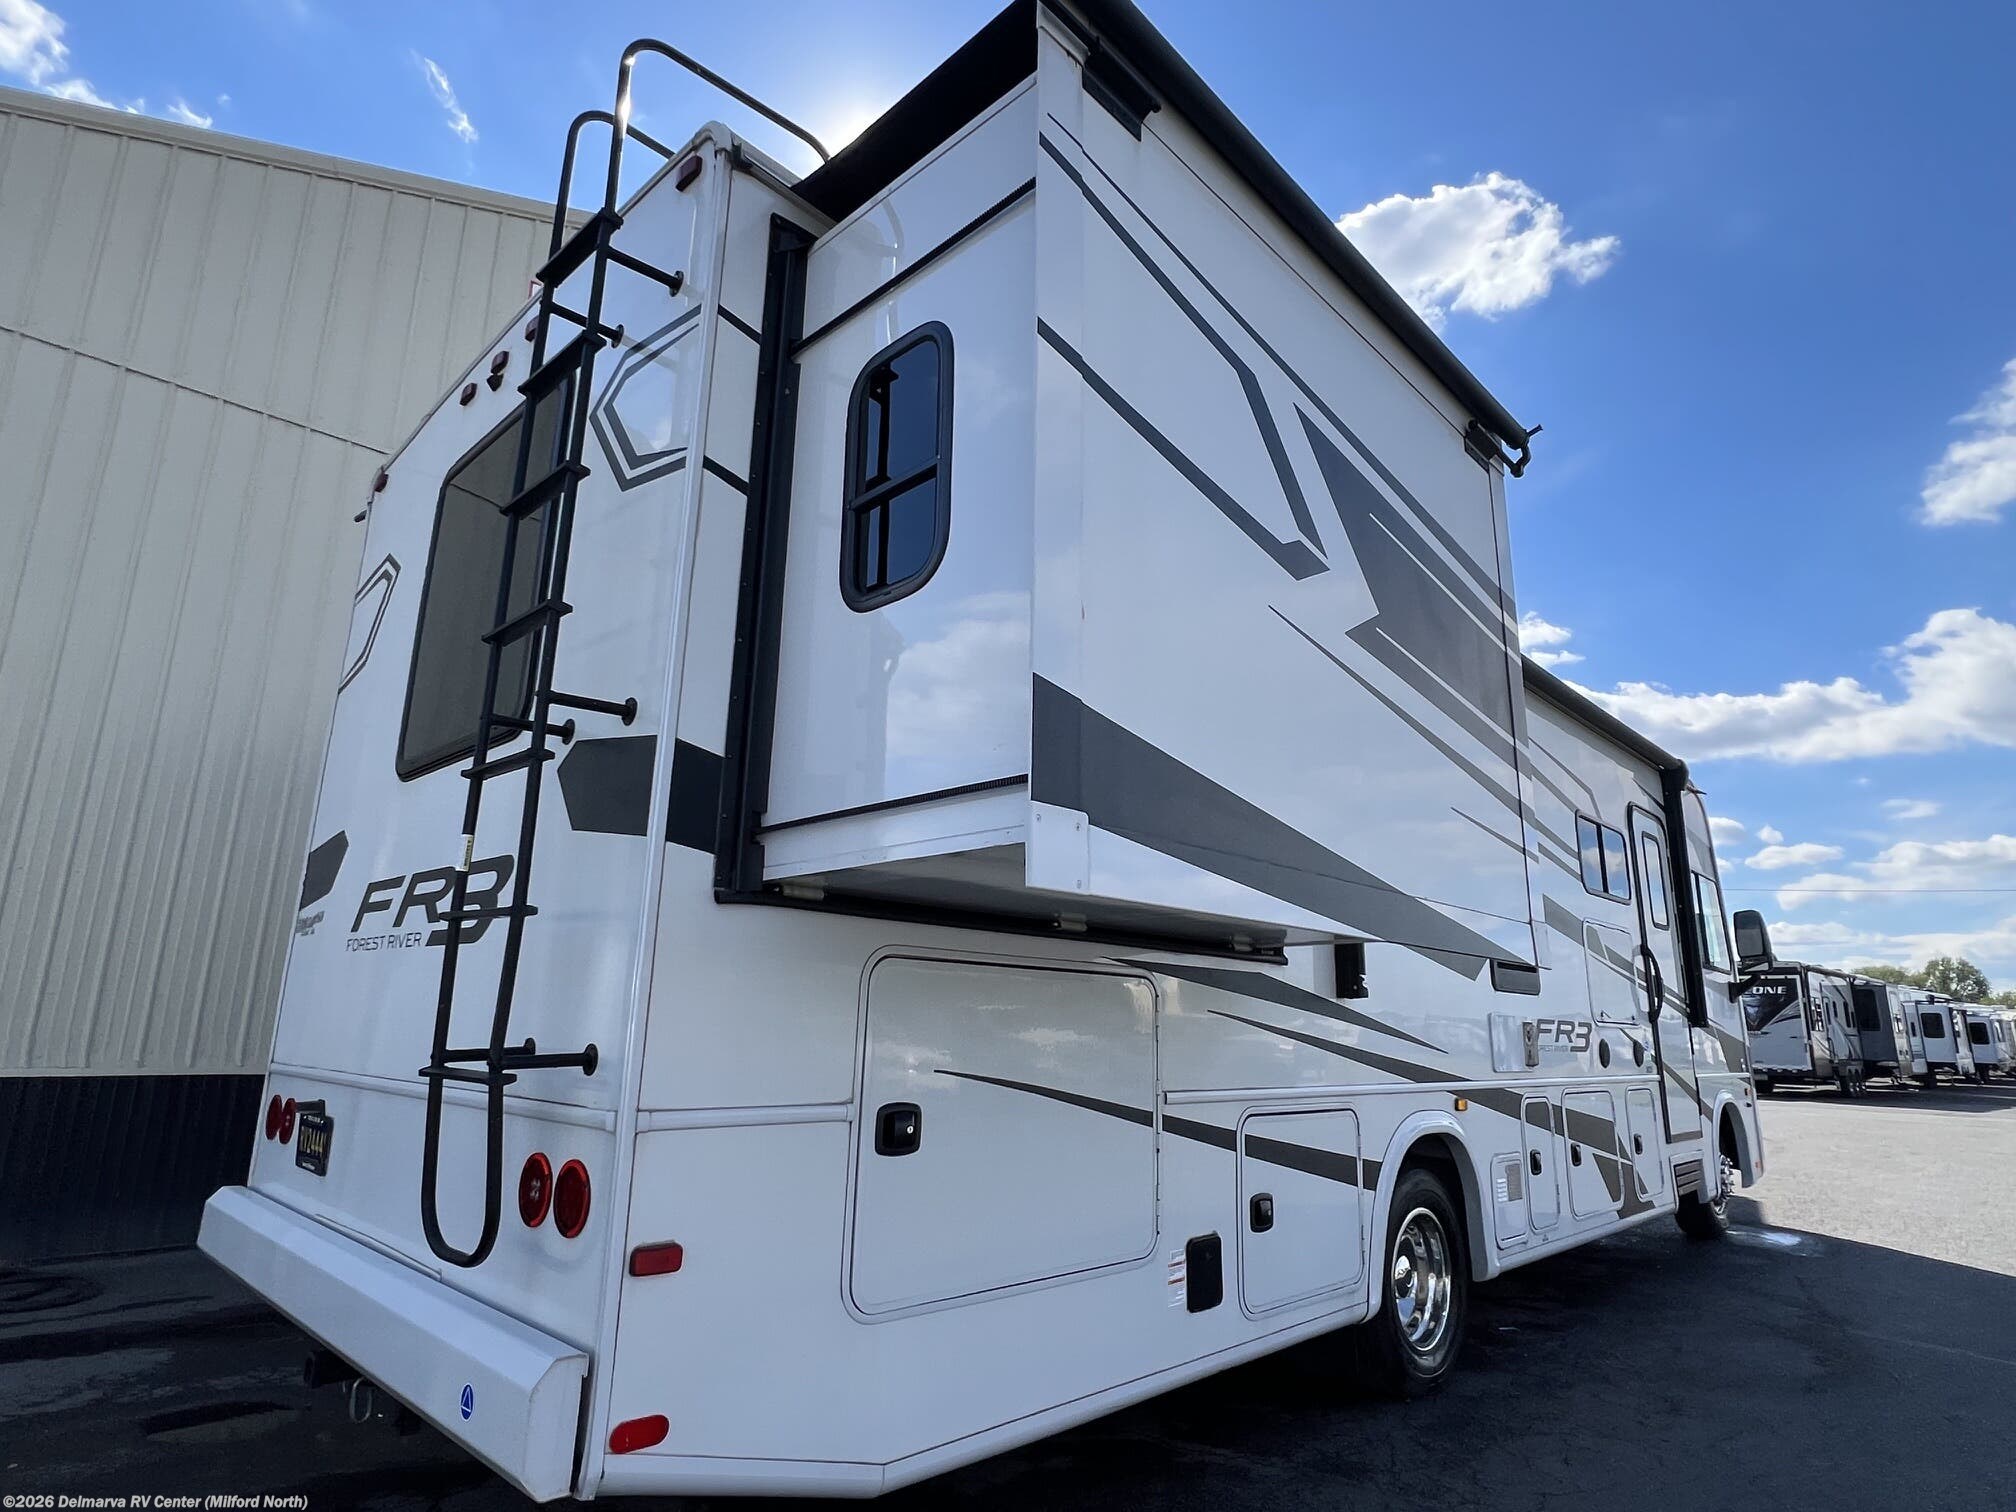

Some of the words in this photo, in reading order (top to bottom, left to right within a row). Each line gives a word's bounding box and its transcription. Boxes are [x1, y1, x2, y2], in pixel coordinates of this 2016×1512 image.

[351, 854, 515, 947] FR3
[346, 935, 385, 952] FOREST
[387, 932, 422, 949] RIVER
[1536, 1019, 1592, 1052] FR3
